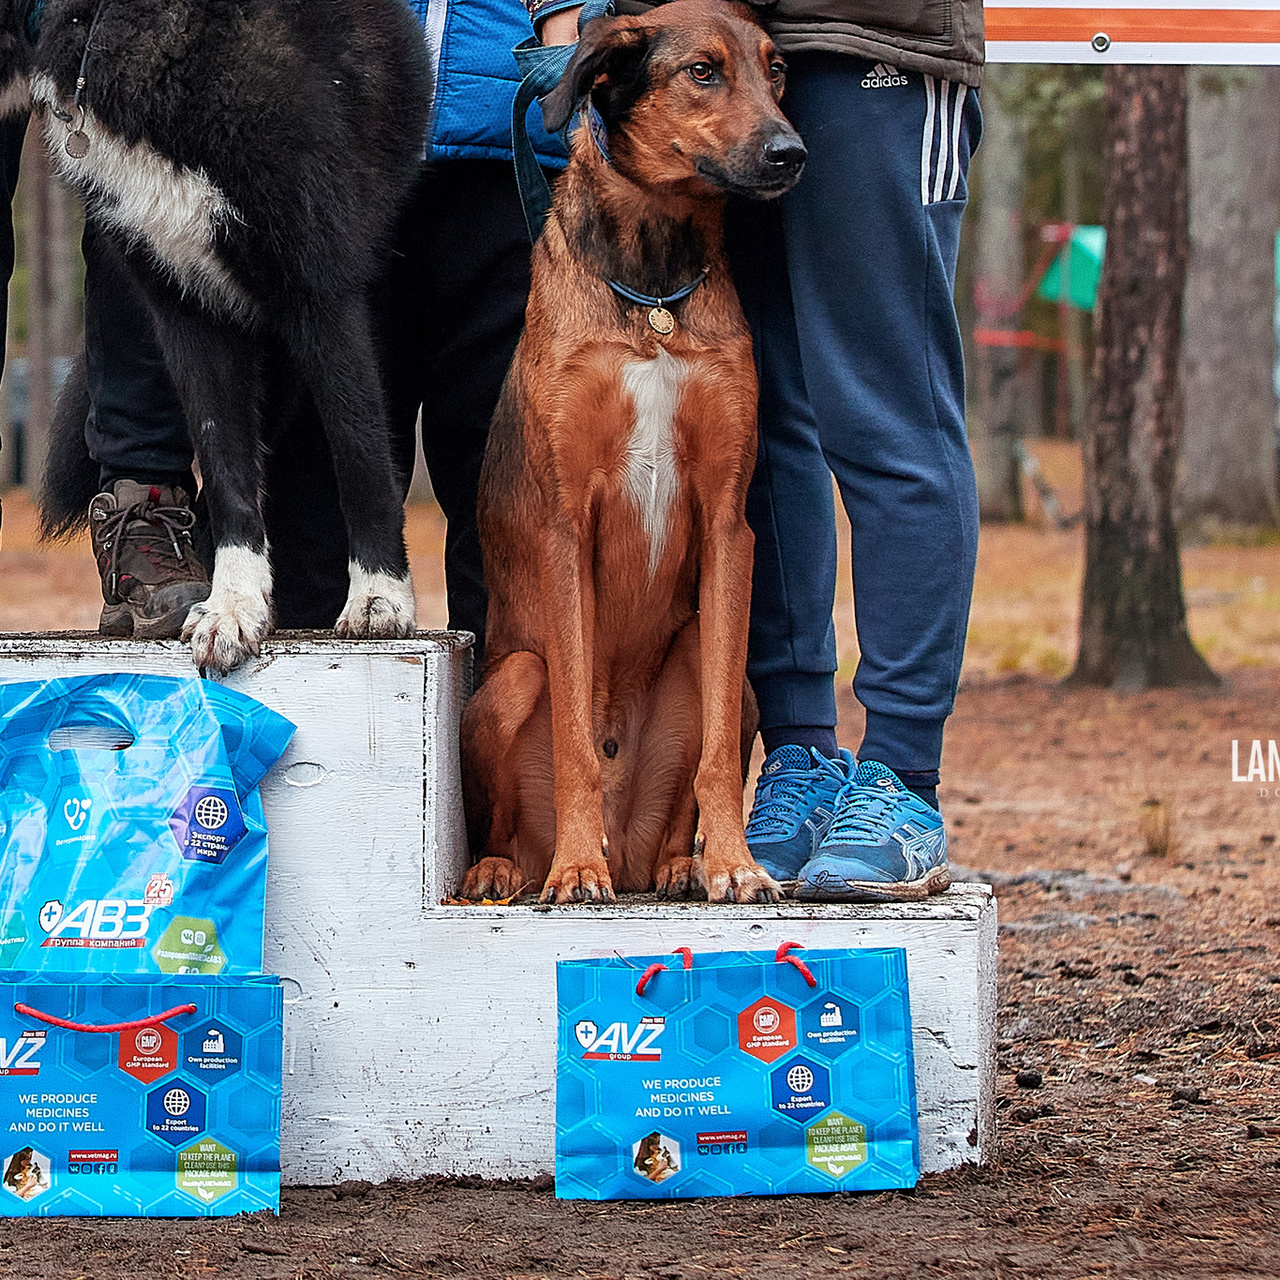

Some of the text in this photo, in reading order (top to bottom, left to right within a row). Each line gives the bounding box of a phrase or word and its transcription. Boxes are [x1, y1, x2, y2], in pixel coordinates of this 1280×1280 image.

[861, 75, 909, 89] adidas
[55, 834, 96, 847] Ветеринария
[192, 831, 226, 843] Экспорт
[190, 839, 202, 847] 22
[197, 848, 217, 857] мира
[147, 879, 172, 898] 25
[49, 899, 154, 938] АВЗ
[49, 938, 136, 948] группа компаний
[587, 1022, 666, 1054] AVZ
[752, 1034, 783, 1042] European
[806, 1029, 857, 1039] Own production
[761, 1040, 790, 1048] standard
[818, 1036, 846, 1044] facilities
[132, 1055, 163, 1063] European
[203, 1056, 238, 1064] production
[608, 1053, 632, 1061] group
[641, 1076, 721, 1090] WE PRODUCE
[18, 1093, 98, 1104] WE PRODUCE
[650, 1091, 715, 1103] MEDICINES
[790, 1095, 813, 1103] Export
[795, 1101, 825, 1109] countries
[25, 1107, 90, 1118] MEDICINES
[634, 1105, 732, 1117] AND DO IT WELL
[8, 1122, 105, 1132] AND DO IT WELL
[165, 1118, 187, 1126] Export
[826, 1117, 843, 1127] WANT
[698, 1133, 746, 1141] www.vetmag.ru
[199, 1143, 216, 1153] WANT
[70, 1152, 118, 1160] www.vetmag.ru
